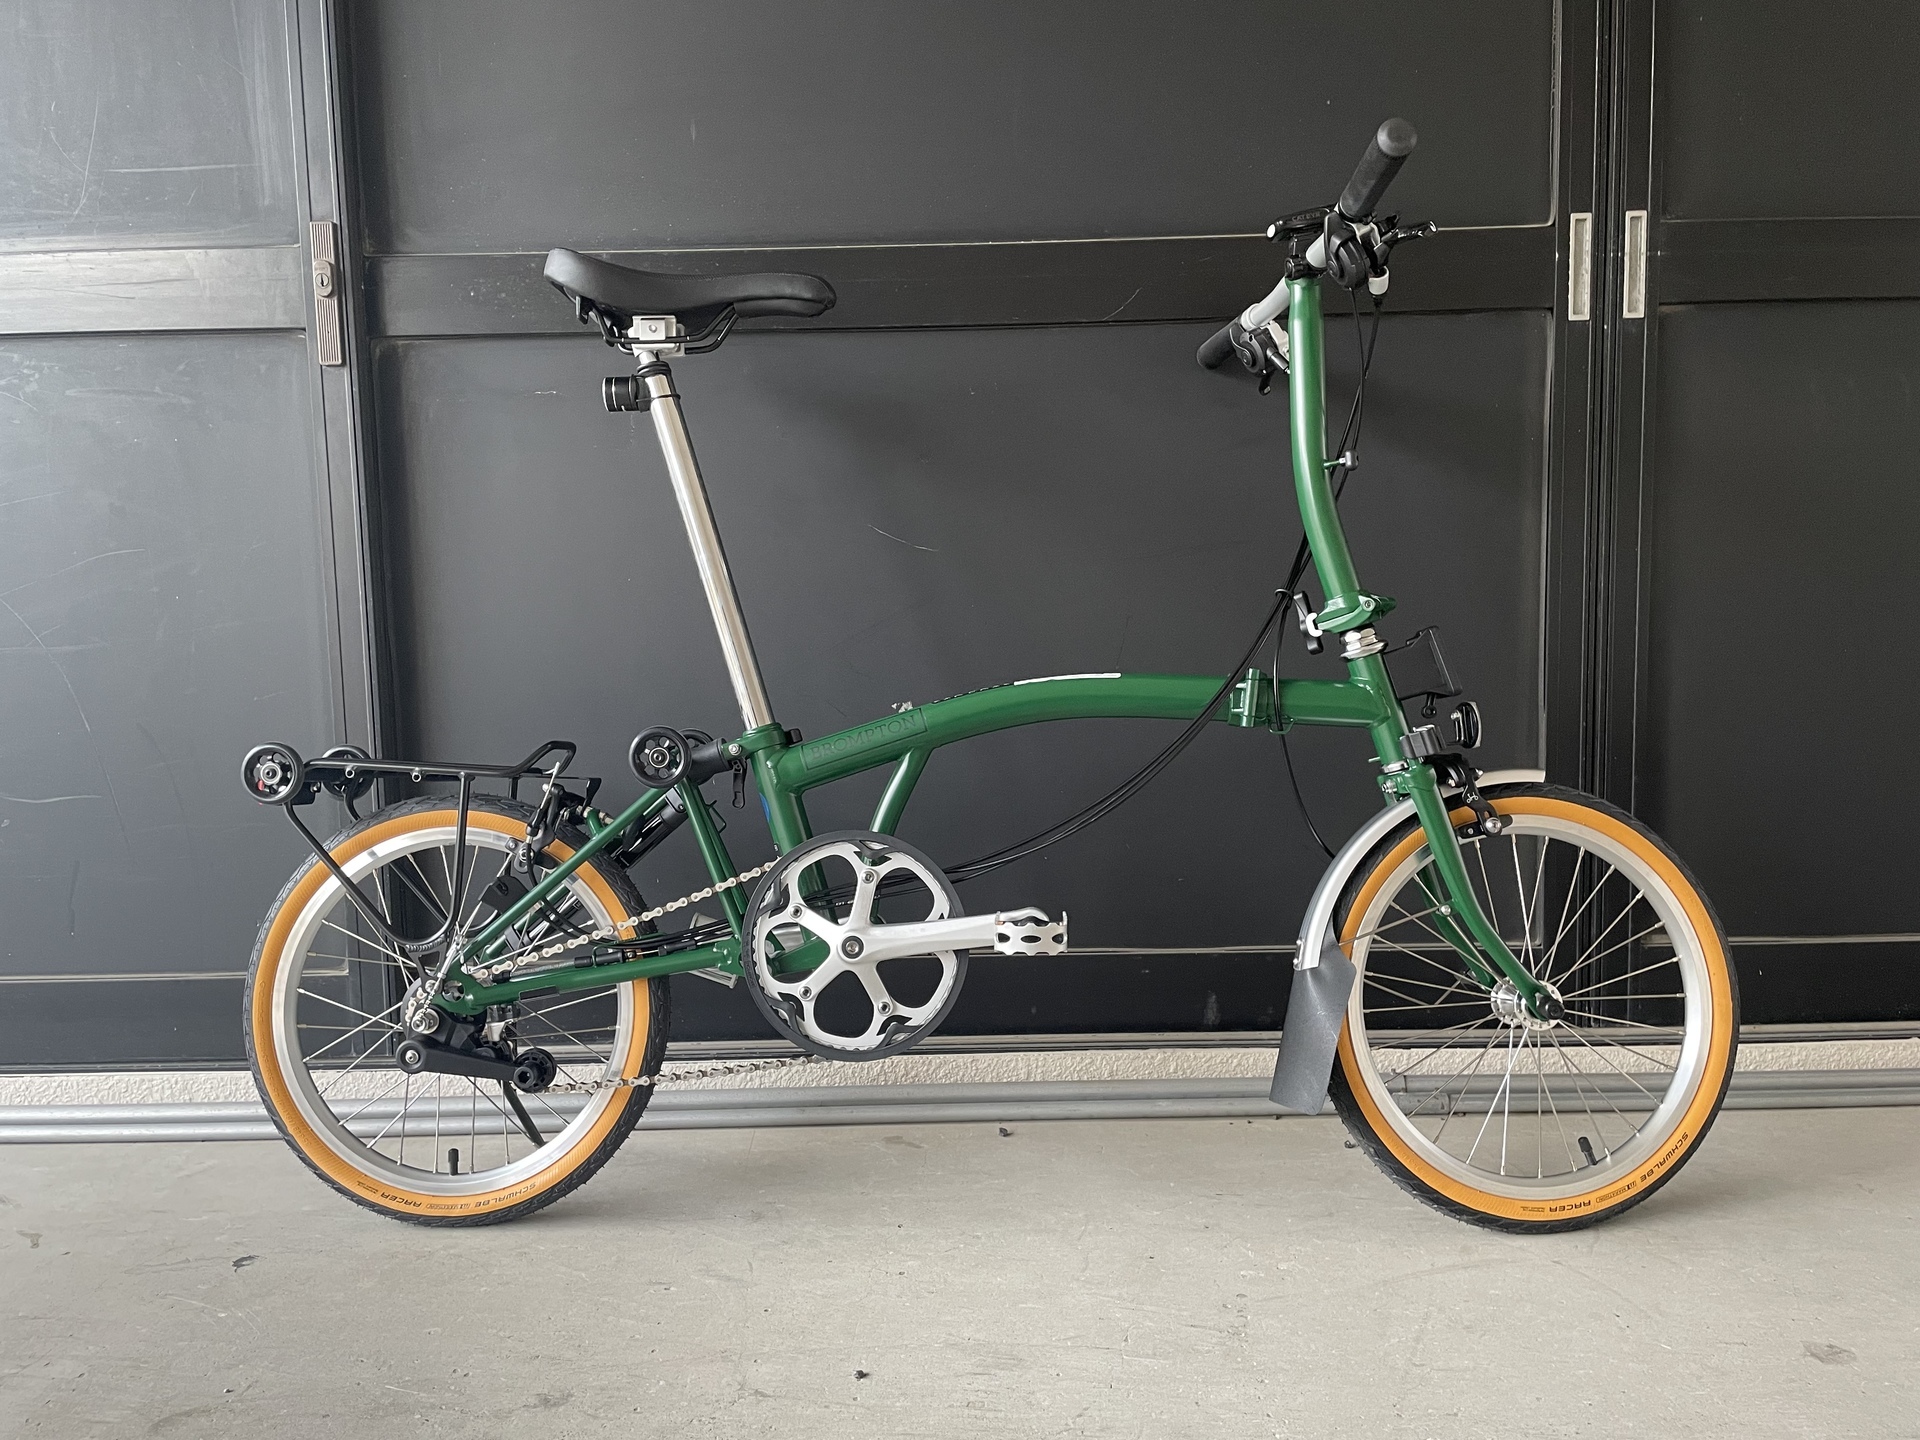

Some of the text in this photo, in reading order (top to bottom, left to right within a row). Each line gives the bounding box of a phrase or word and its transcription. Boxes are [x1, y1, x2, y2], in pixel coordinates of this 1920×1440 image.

[809, 714, 917, 760] BROMPTON
[1639, 1131, 1689, 1182] SCHWALBE
[380, 1191, 423, 1208] RACER
[474, 1181, 537, 1208] SCHWALBE
[1549, 1199, 1591, 1212] RACER
